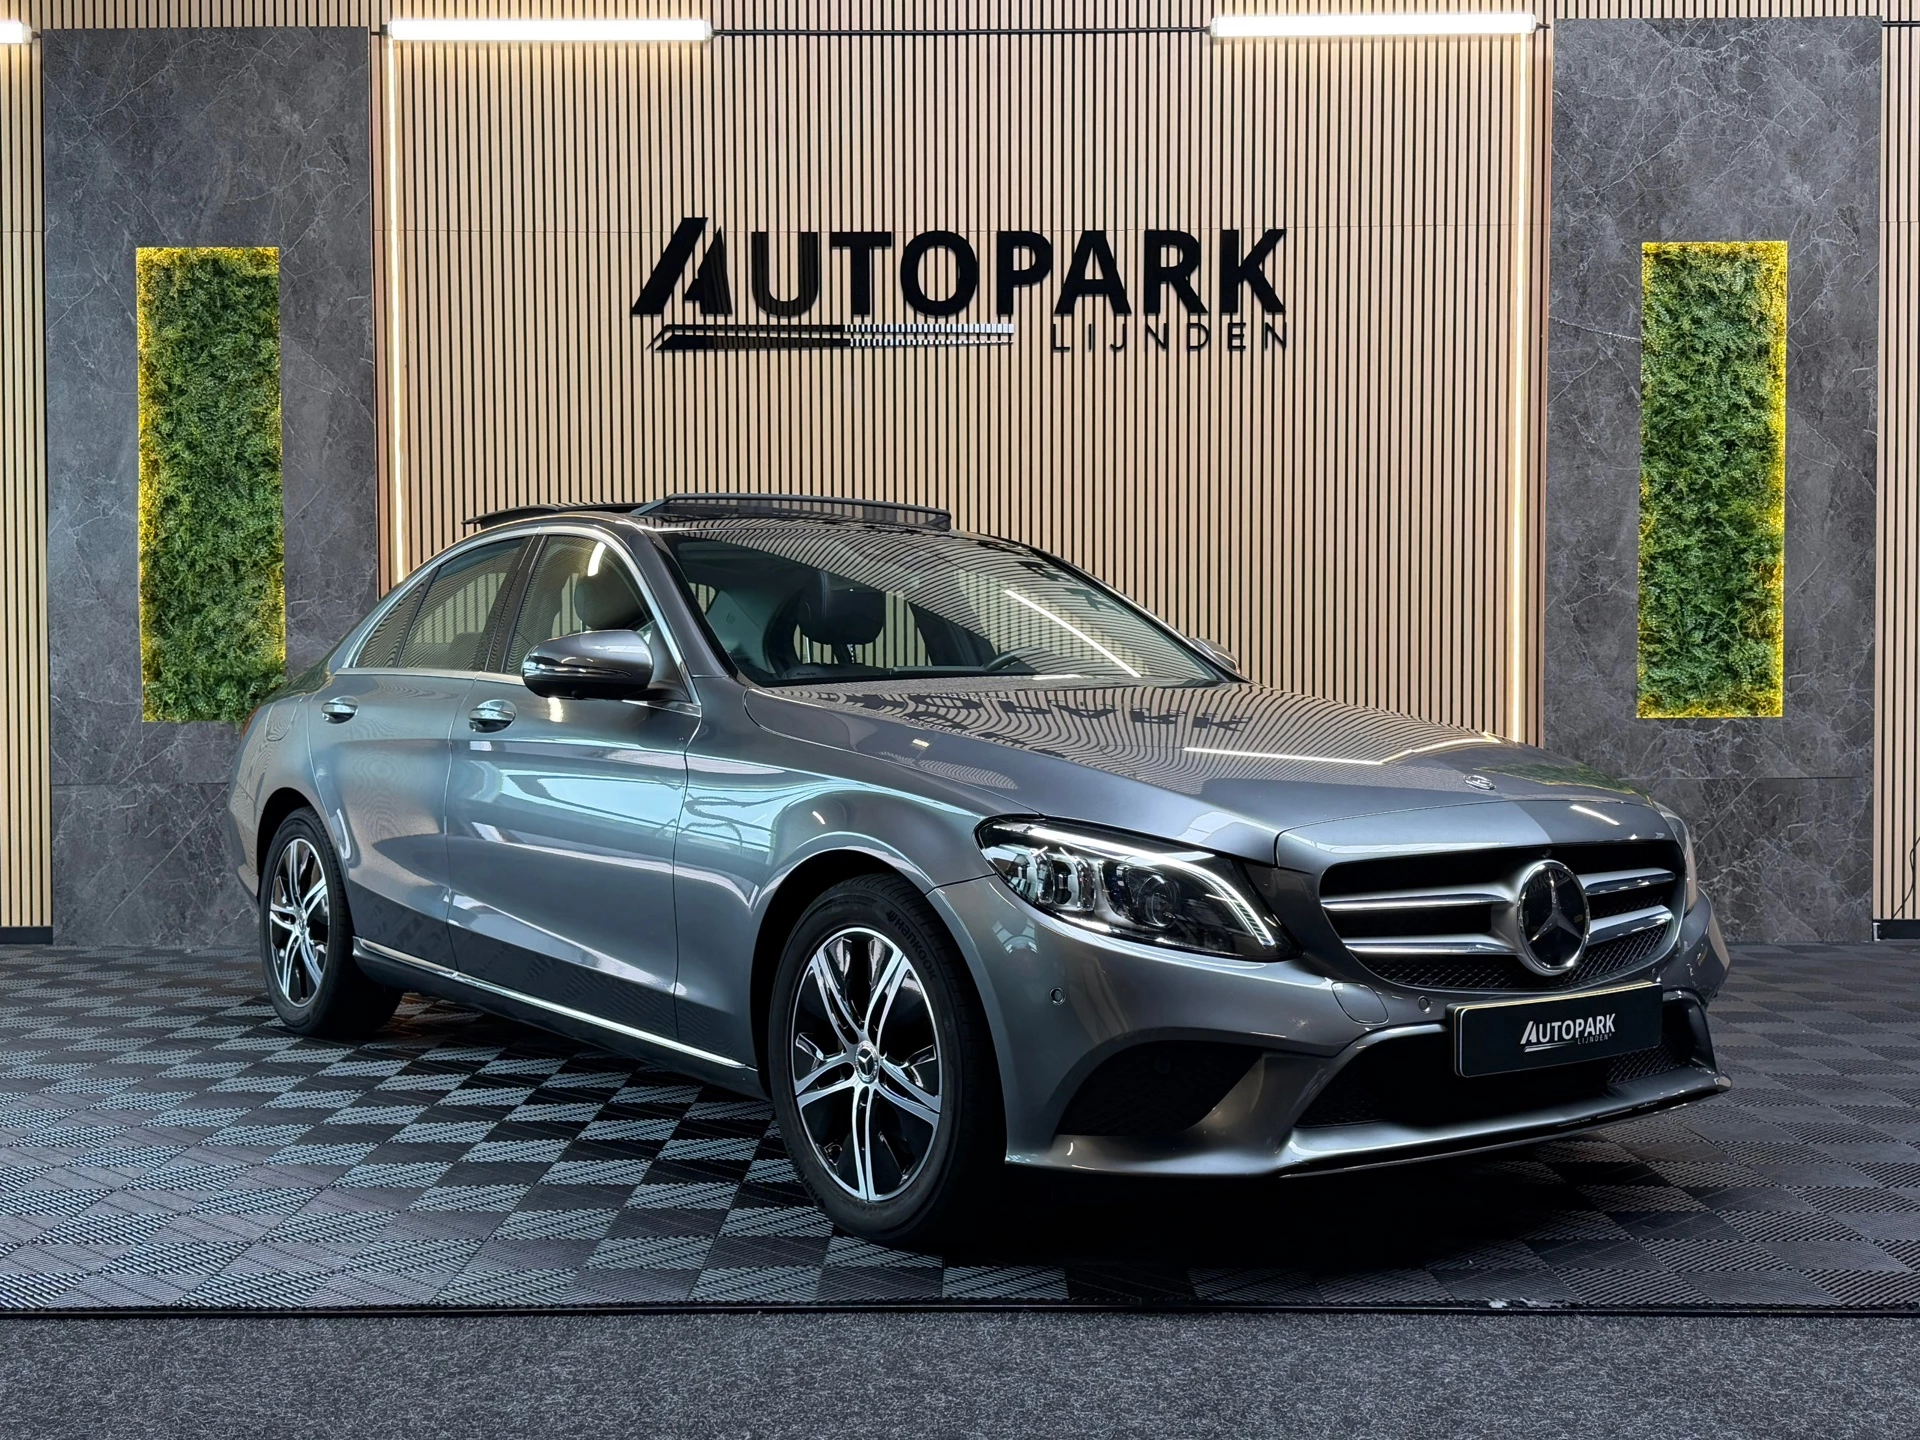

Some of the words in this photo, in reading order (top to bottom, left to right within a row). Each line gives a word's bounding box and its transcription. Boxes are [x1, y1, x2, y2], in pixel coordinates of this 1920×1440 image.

[631, 216, 1287, 316] AUTOPARK
[1052, 322, 1287, 352] LIJNDEN
[1520, 1013, 1616, 1045] AUTOPARK
